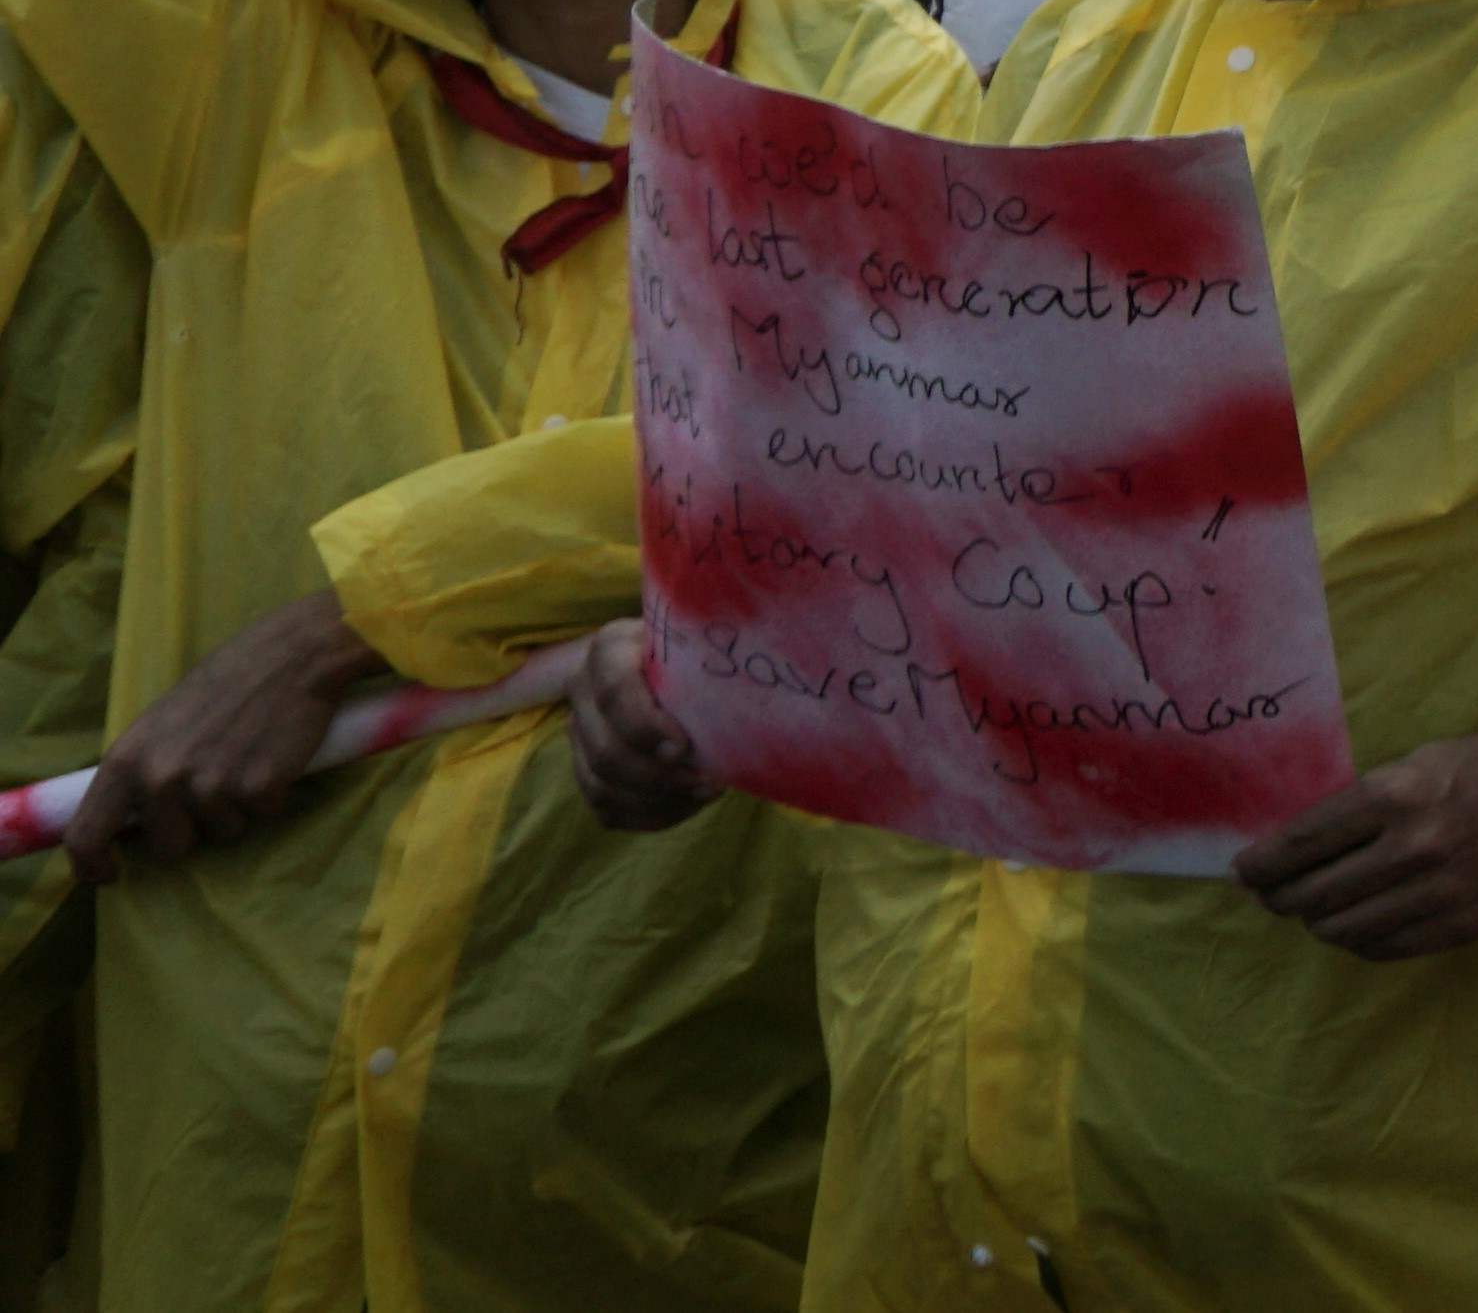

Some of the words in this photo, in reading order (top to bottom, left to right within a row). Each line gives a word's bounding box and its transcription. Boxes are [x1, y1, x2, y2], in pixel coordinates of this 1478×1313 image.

[708, 187, 804, 283] last
[943, 153, 1051, 237] be
[729, 304, 1031, 416] Myanmar
